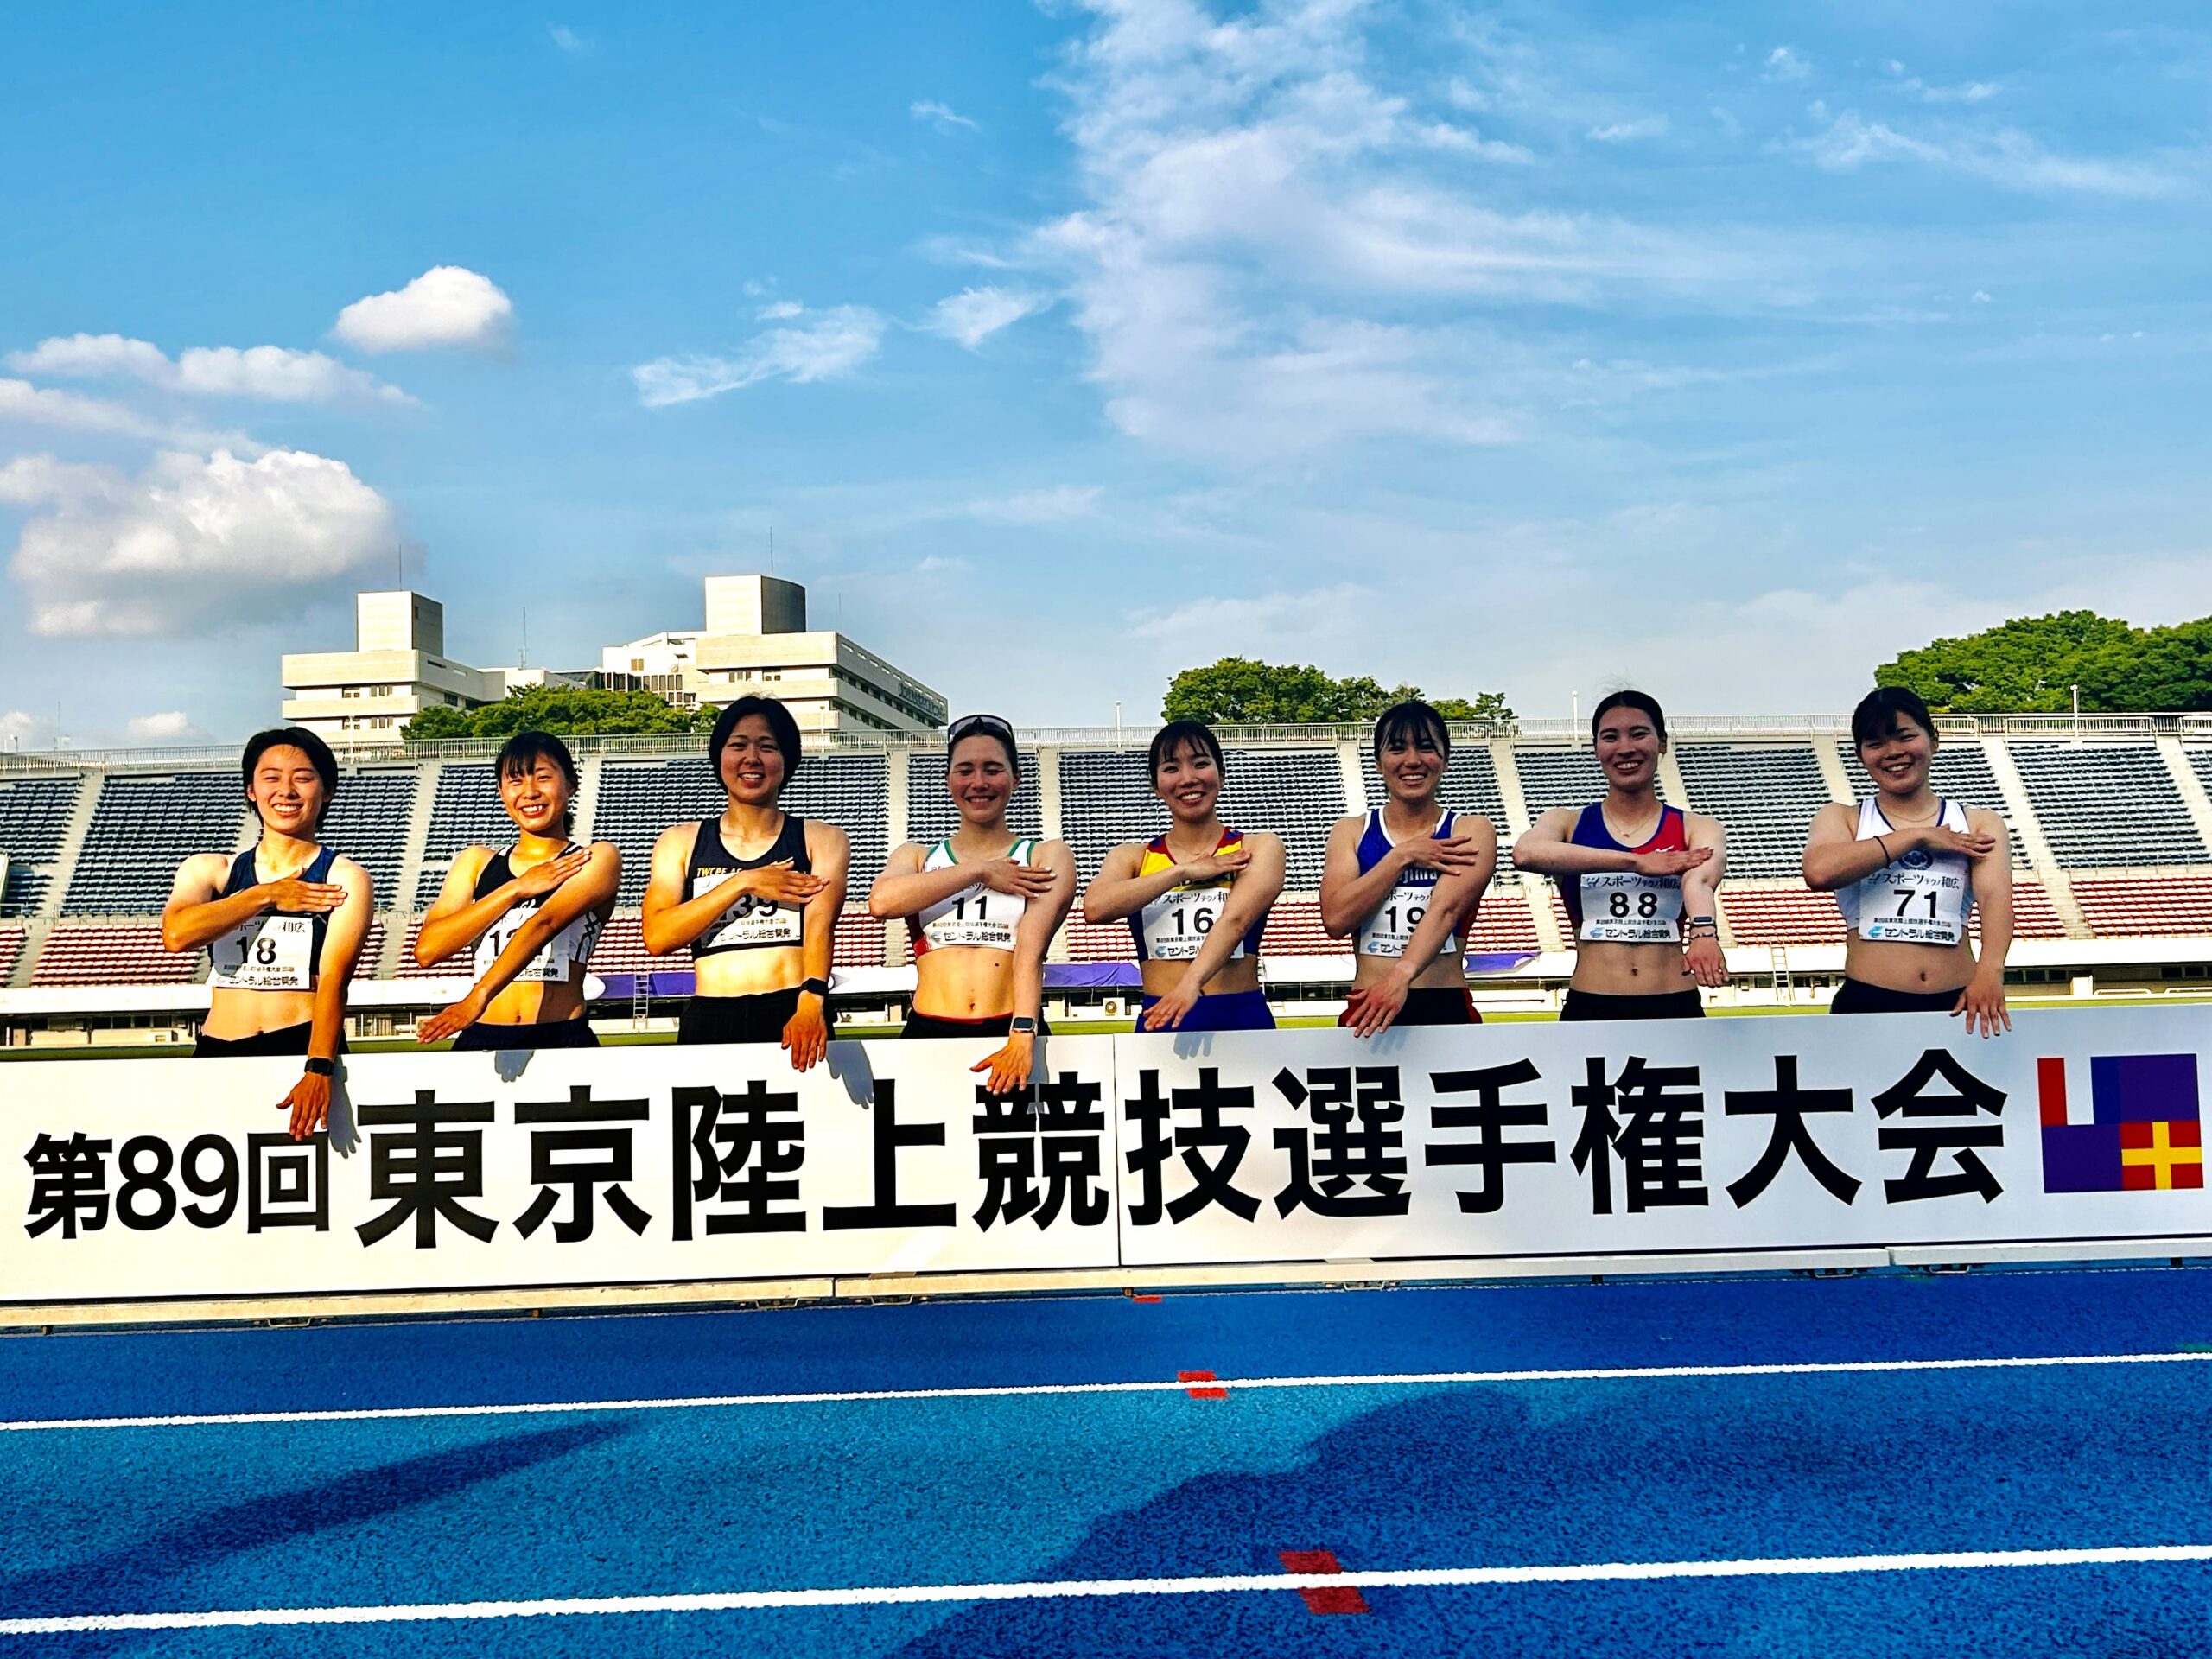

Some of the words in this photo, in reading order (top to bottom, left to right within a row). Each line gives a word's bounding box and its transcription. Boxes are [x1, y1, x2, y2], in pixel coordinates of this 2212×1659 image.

[718, 893, 779, 920] 39
[951, 895, 988, 920] 11
[1609, 892, 1658, 918] 88
[1894, 889, 1937, 918] 71
[1171, 907, 1214, 936] 16
[1384, 906, 1427, 933] 19
[236, 936, 276, 965] 18
[23, 1048, 2008, 1252] 第89回東京陸上競技選手権大会
